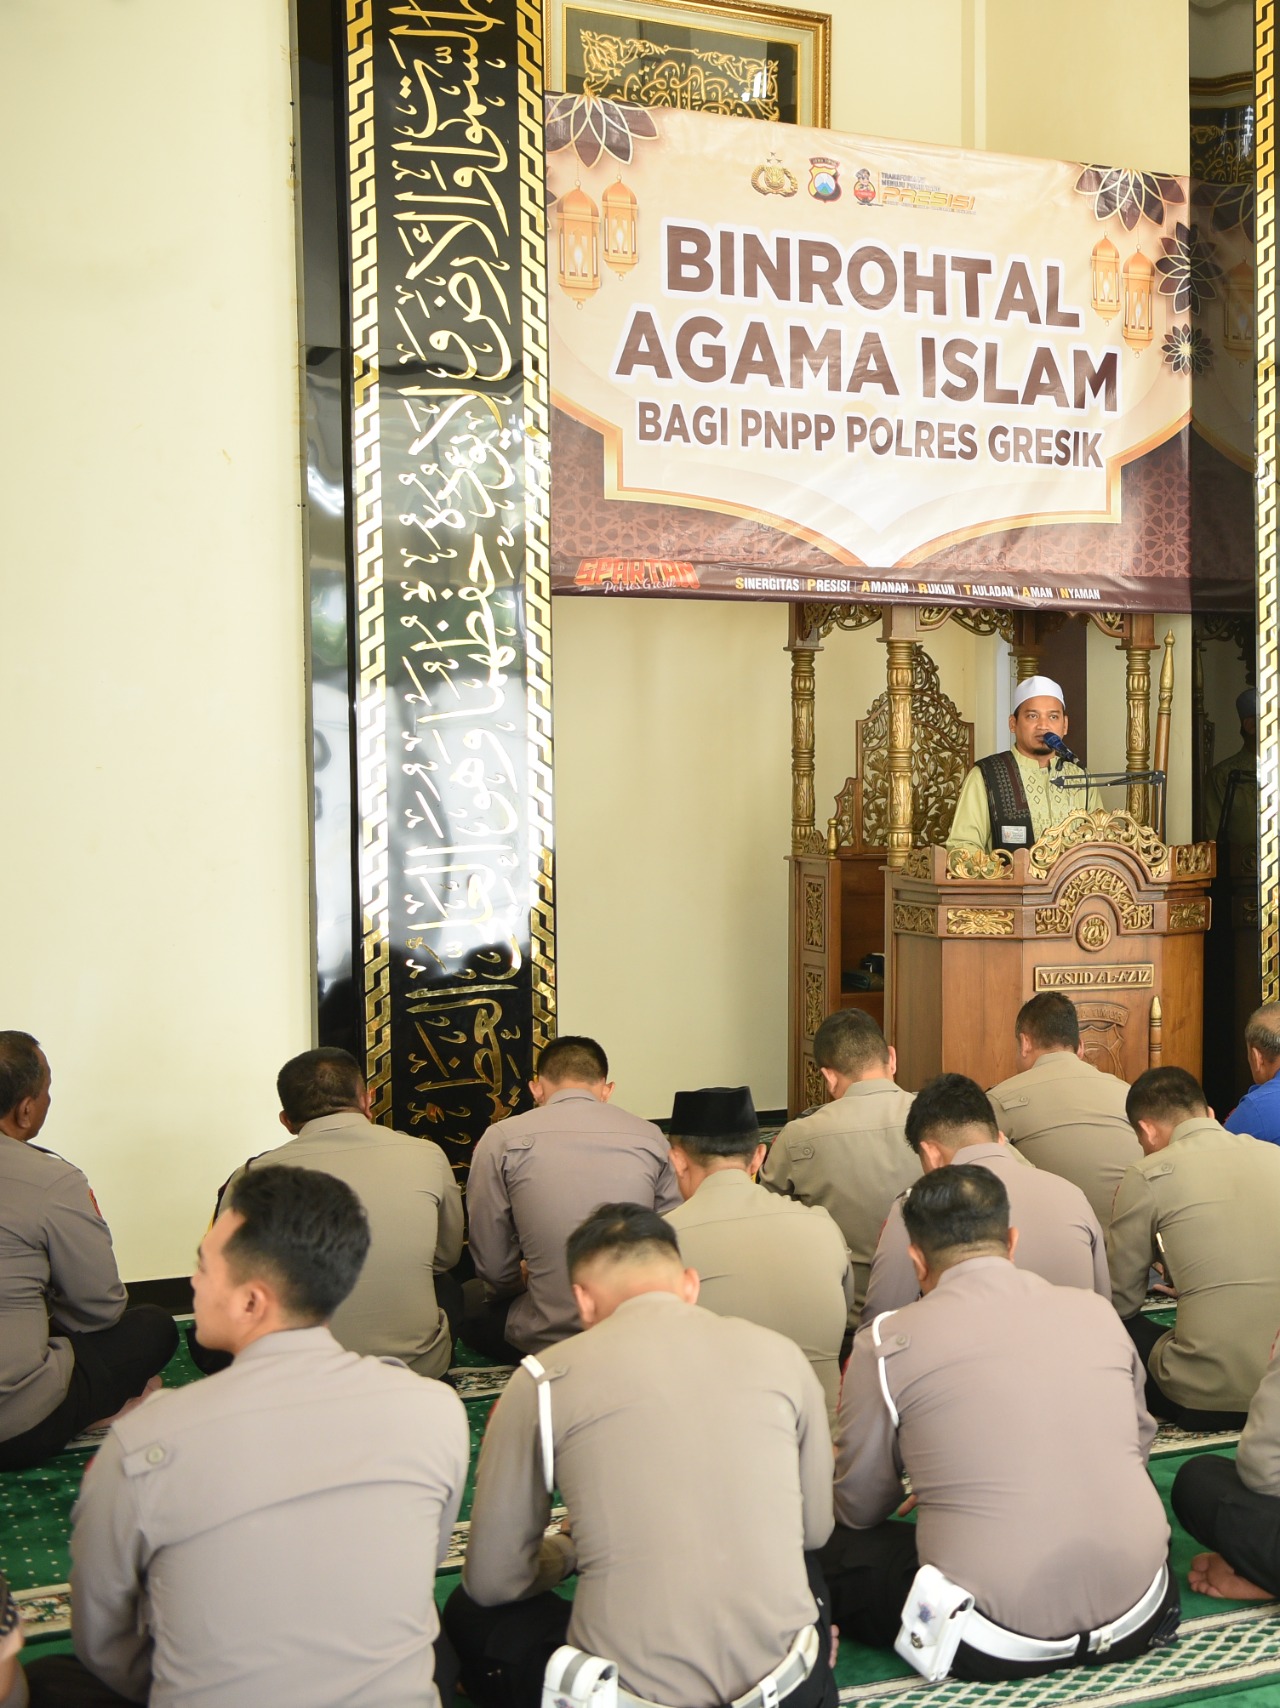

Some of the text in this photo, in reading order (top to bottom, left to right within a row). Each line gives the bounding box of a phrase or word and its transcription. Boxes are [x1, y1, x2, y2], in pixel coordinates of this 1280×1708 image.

[882, 187, 976, 210] PRESISI
[667, 225, 1079, 327] BINROHTAL
[615, 311, 1118, 412] AGAMA ISLAM
[638, 402, 1103, 467] BAGI PNPP POLRES GRESIK
[574, 557, 700, 589] SPARTAN
[602, 580, 640, 594] Polres
[735, 577, 1100, 600] SINERGITAS PRESISI AMANAH RUKUN TAULADAN AMAN NYAMAN
[1042, 969, 1152, 985] MASJID AL-AZIZ
